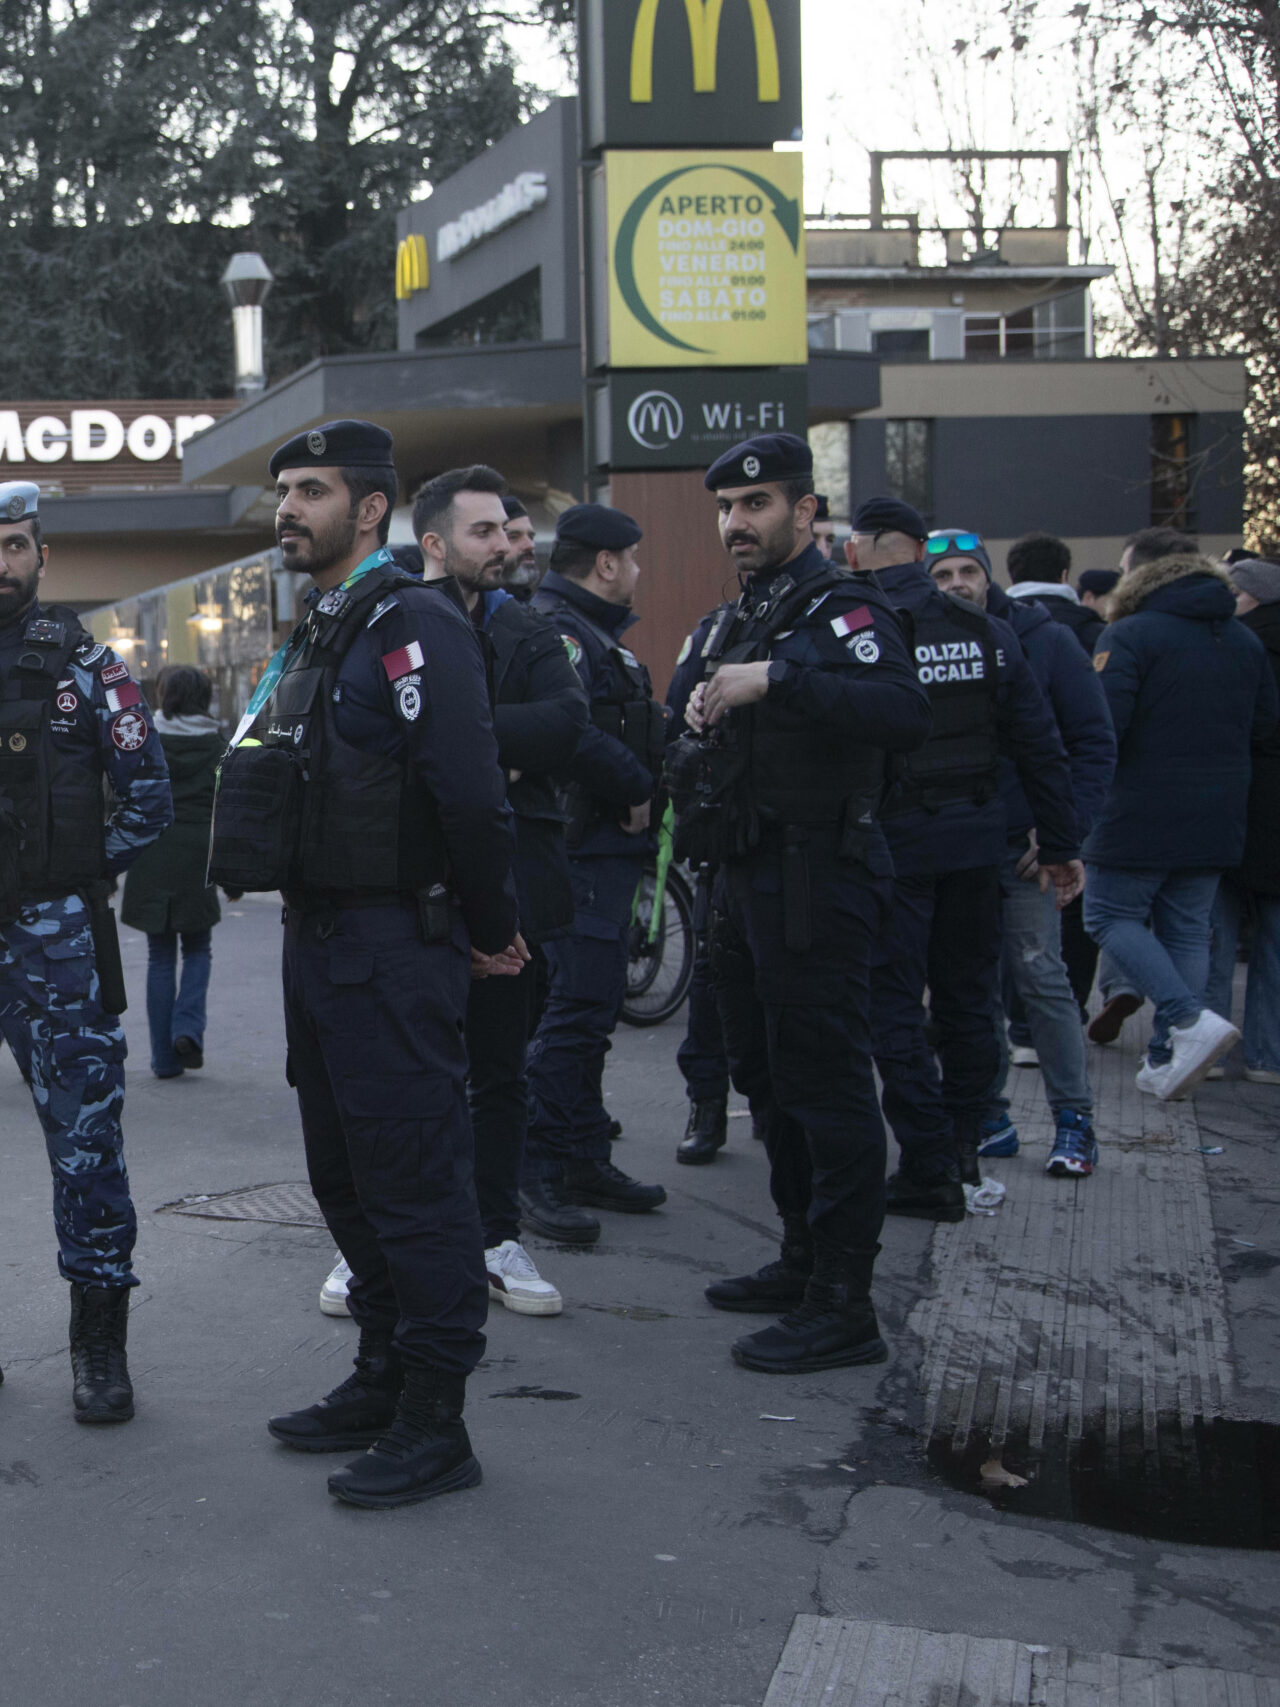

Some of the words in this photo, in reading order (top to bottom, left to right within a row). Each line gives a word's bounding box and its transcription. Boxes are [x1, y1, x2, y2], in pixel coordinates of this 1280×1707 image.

[659, 194, 763, 215] APERTO
[658, 218, 765, 238] DOM-GIO
[660, 287, 767, 308] SABATO
[702, 402, 785, 429] Wi-Fi
[914, 641, 983, 663] OLIZIA
[917, 661, 984, 684] OCALE
